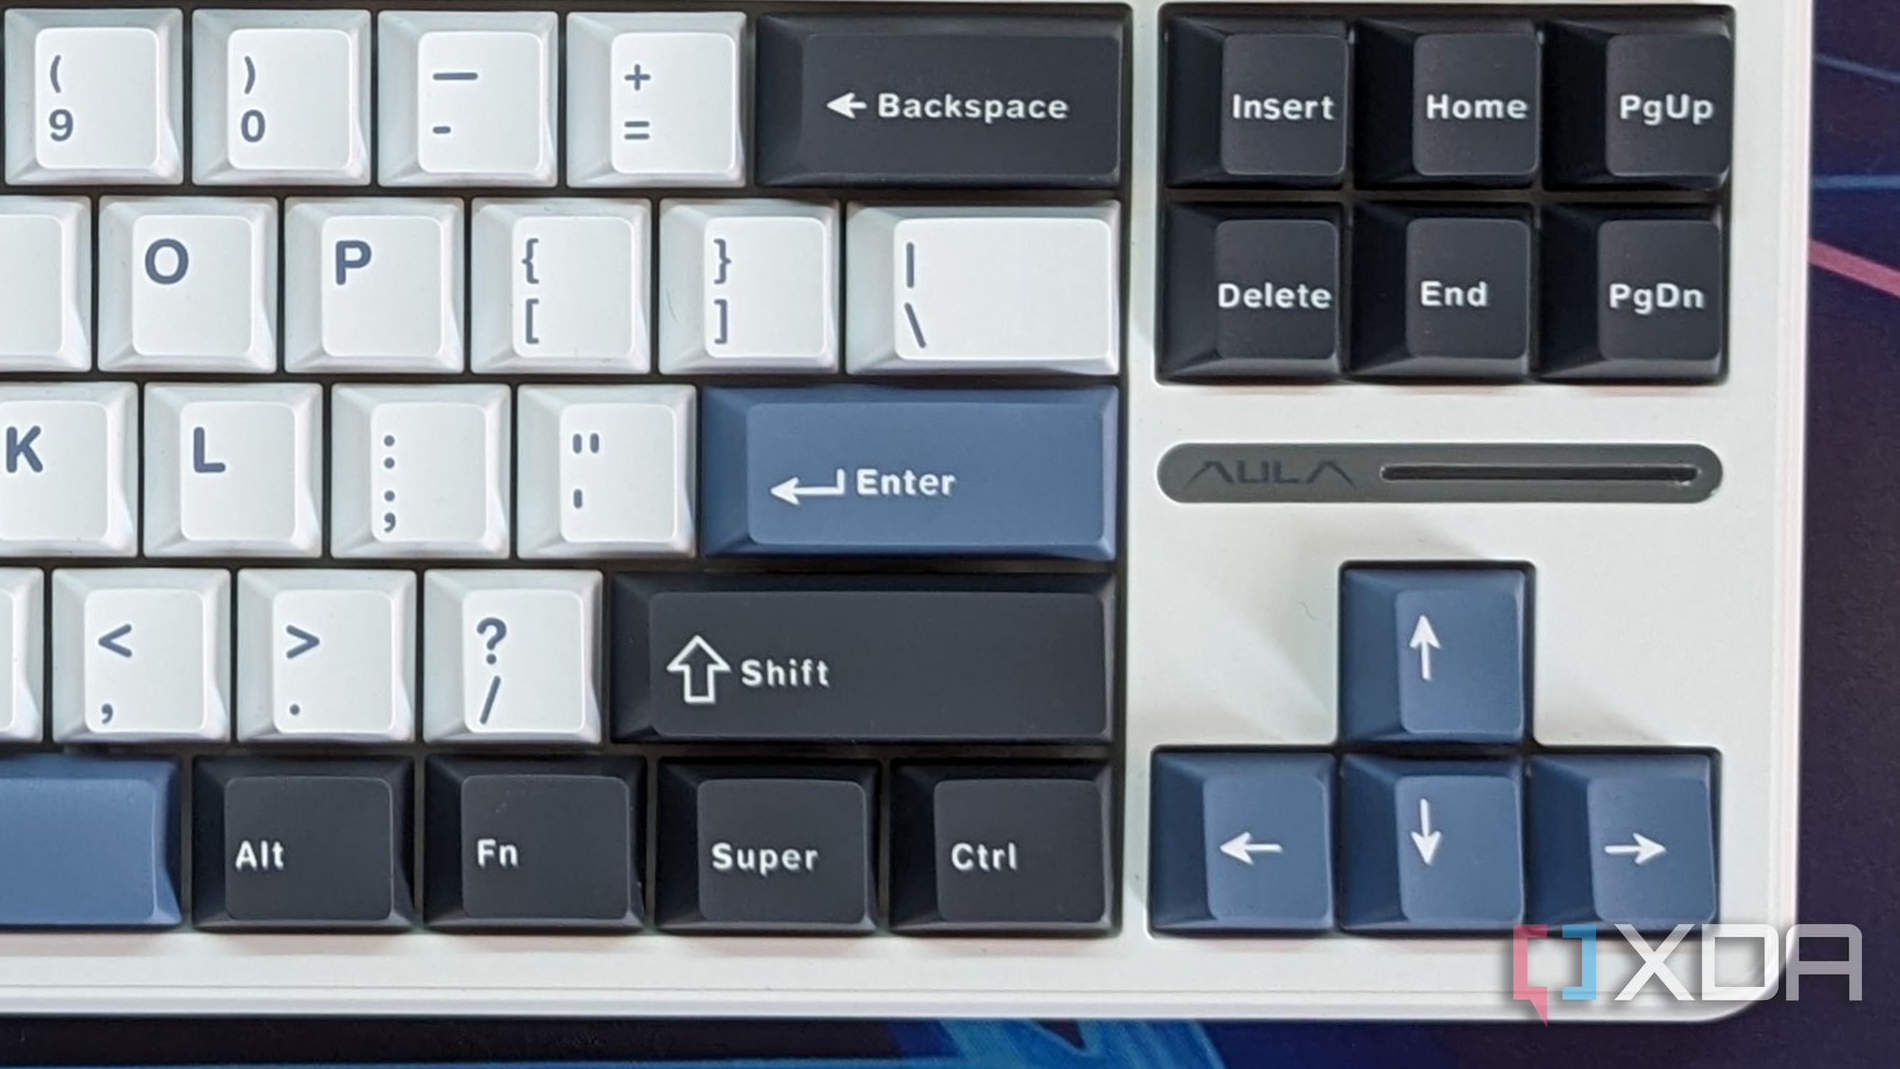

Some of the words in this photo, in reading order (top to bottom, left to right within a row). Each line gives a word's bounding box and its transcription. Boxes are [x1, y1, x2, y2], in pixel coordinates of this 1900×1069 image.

[49, 54, 62, 94] (
[244, 55, 256, 95] )
[624, 63, 652, 91] +
[878, 92, 1068, 124] Backspace
[1232, 93, 1334, 121] Insert
[1426, 93, 1528, 120] Home
[1620, 93, 1714, 126] PgUp
[48, 108, 74, 142] 9
[240, 109, 266, 143] 0
[624, 120, 651, 140] =
[144, 238, 189, 285] O
[335, 239, 373, 286] P
[521, 237, 540, 285] {
[713, 238, 732, 285] }
[1218, 282, 1332, 309] Delete
[1421, 280, 1487, 307] End
[1609, 282, 1704, 315] PgDn
[525, 298, 540, 345] [
[713, 298, 728, 345] ]
[5, 425, 44, 474] K
[193, 426, 227, 474] L
[383, 434, 396, 470] :
[856, 468, 956, 496] Enter
[1184, 460, 1356, 490] AULA
[98, 623, 133, 659] <
[286, 625, 321, 660] >
[476, 617, 507, 665] ?
[741, 658, 829, 687] Shift
[479, 675, 502, 725] /
[235, 840, 284, 869] Alt
[477, 838, 518, 866] Fn
[711, 842, 818, 876] Super
[951, 842, 1017, 871] Ctrl
